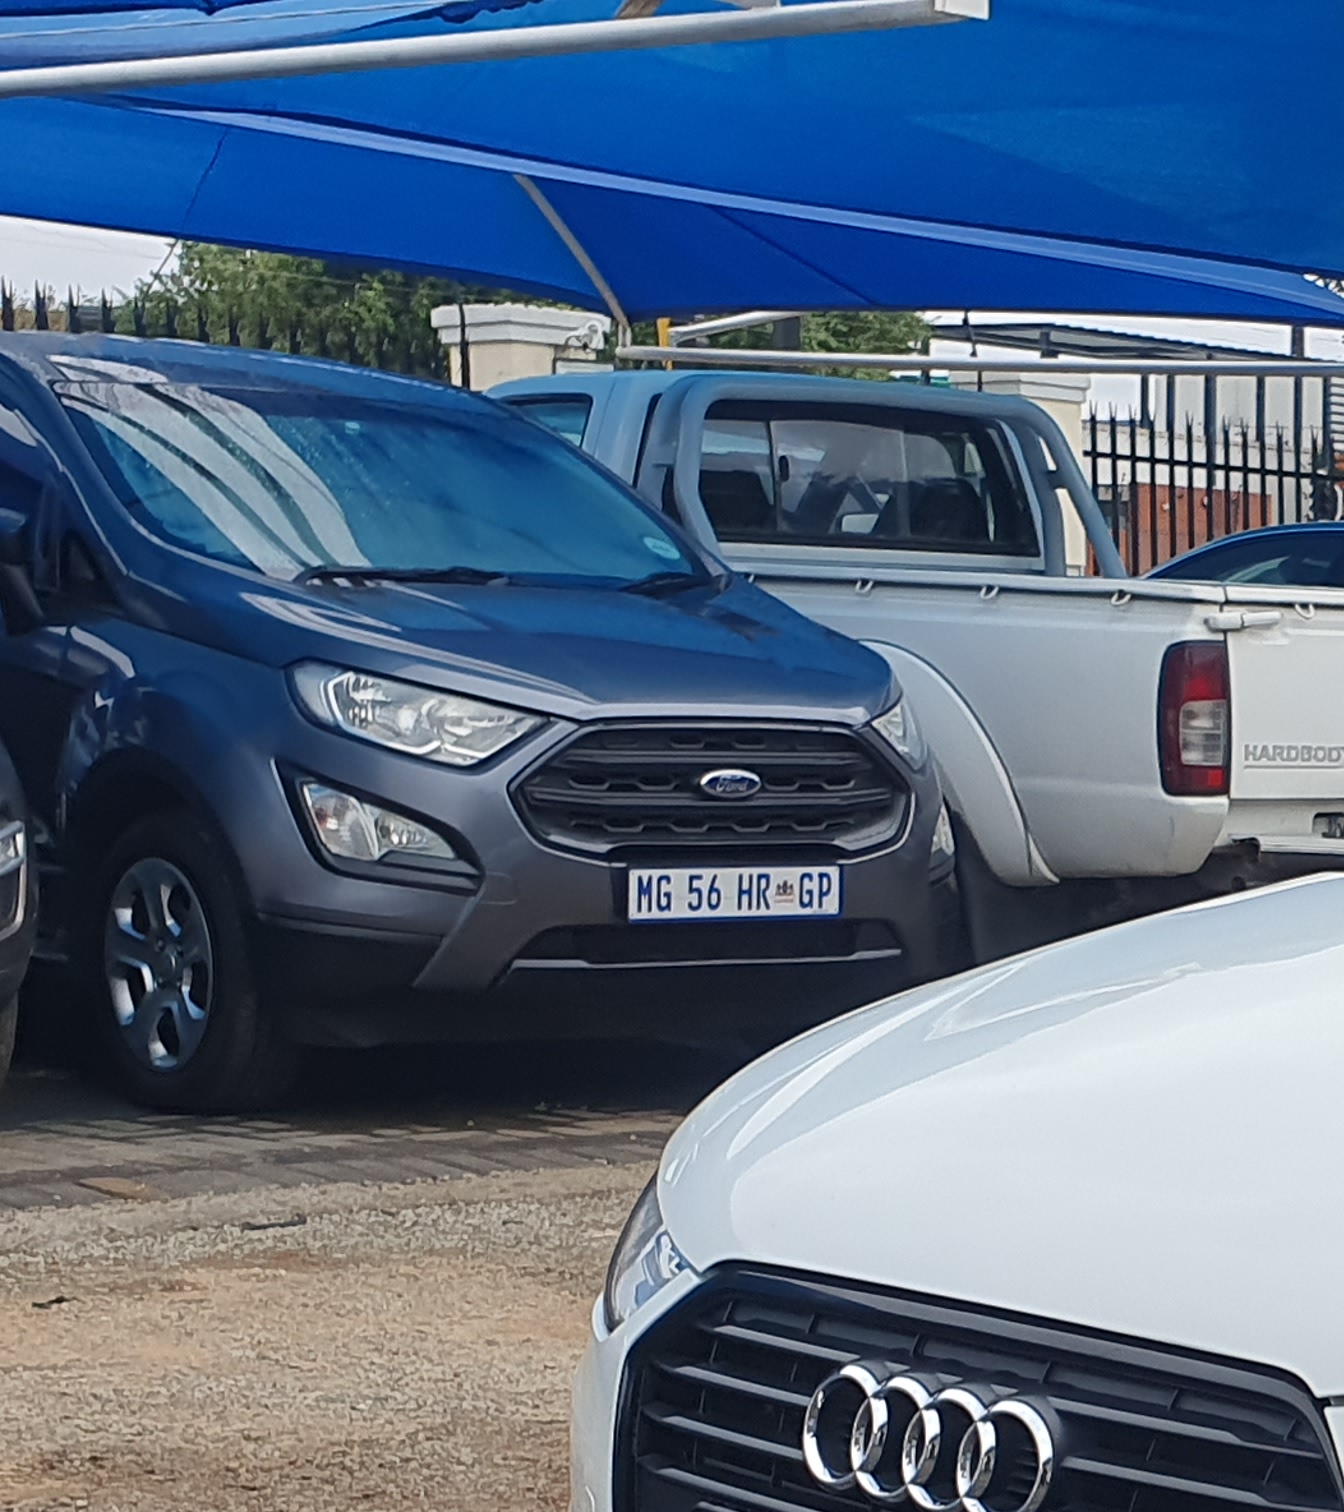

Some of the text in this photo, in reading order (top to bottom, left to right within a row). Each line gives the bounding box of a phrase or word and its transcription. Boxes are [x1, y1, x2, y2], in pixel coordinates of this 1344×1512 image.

[637, 872, 832, 913] MG 56 HR GP
